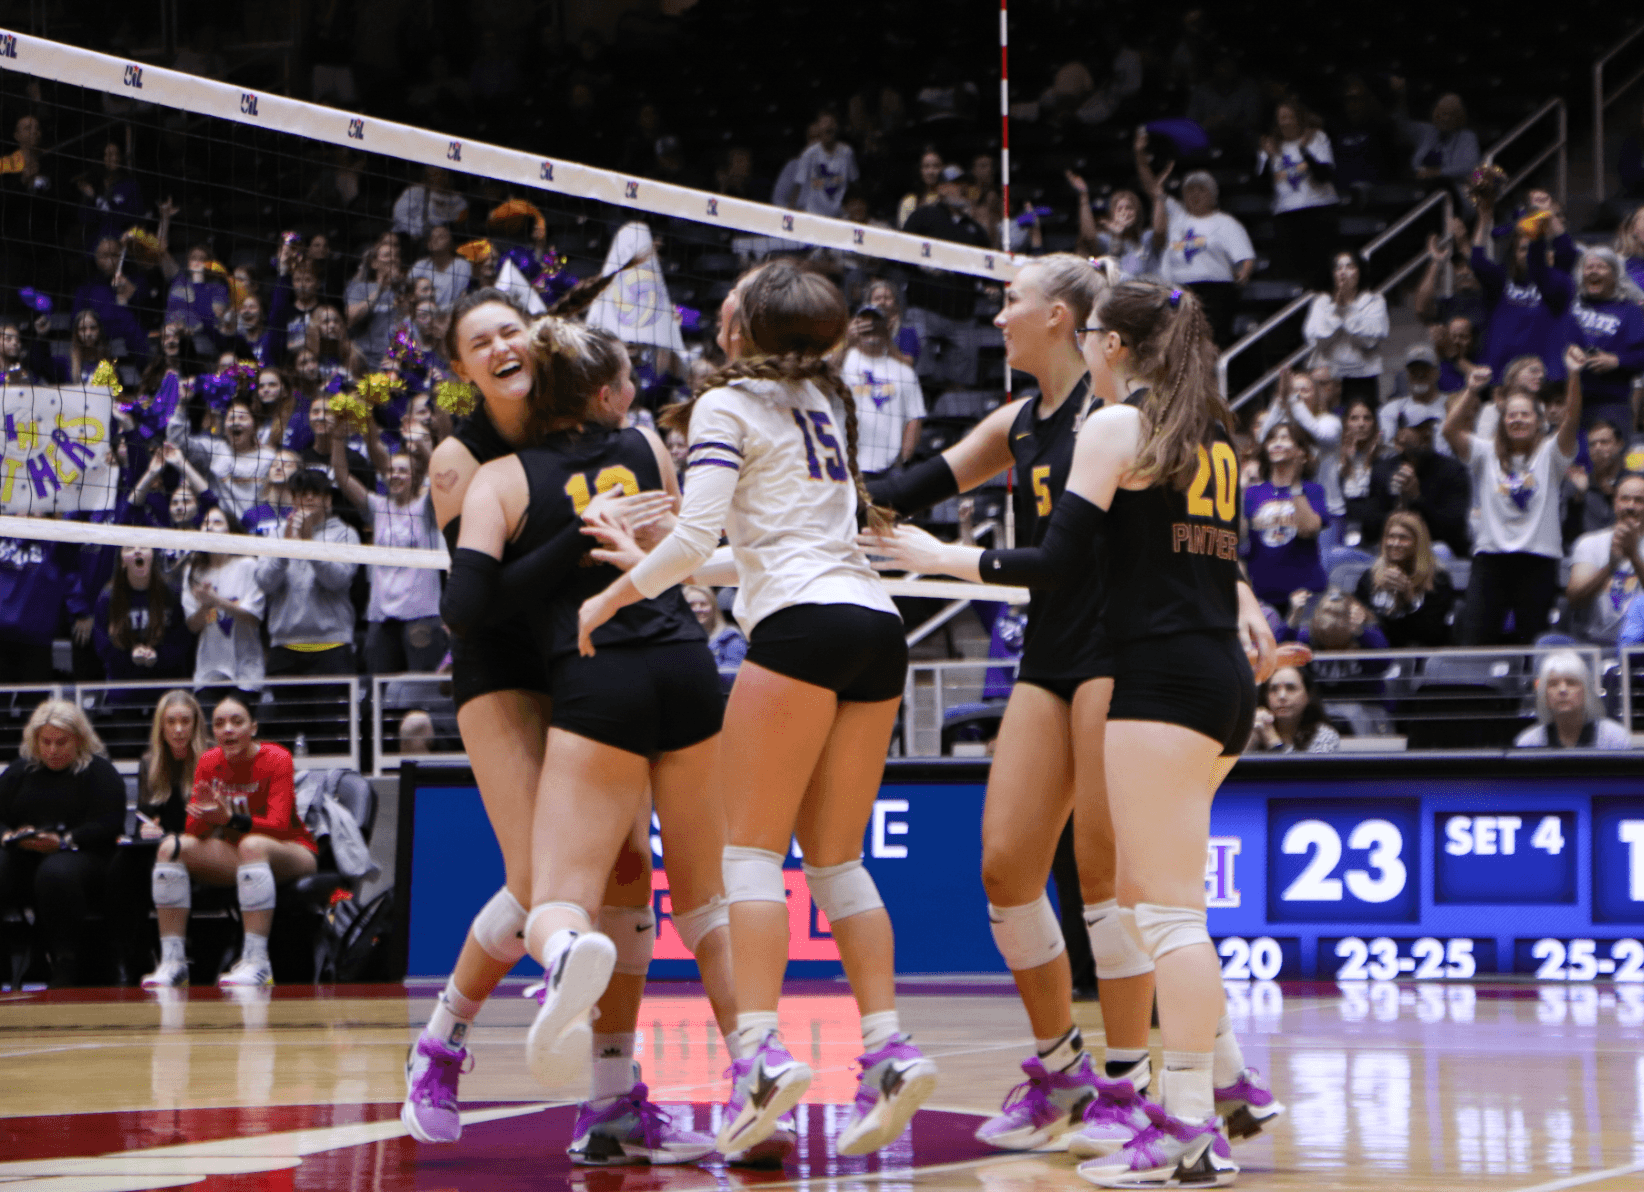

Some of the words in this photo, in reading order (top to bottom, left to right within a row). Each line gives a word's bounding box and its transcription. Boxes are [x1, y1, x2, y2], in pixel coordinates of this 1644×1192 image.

[791, 407, 848, 484] 15
[1032, 465, 1052, 516] 5
[1187, 441, 1238, 522] 20
[1281, 819, 1407, 903] 23
[1445, 816, 1522, 856] SET
[1530, 816, 1565, 855] 4
[1218, 936, 1283, 981] 20
[1336, 937, 1477, 981] 23-25
